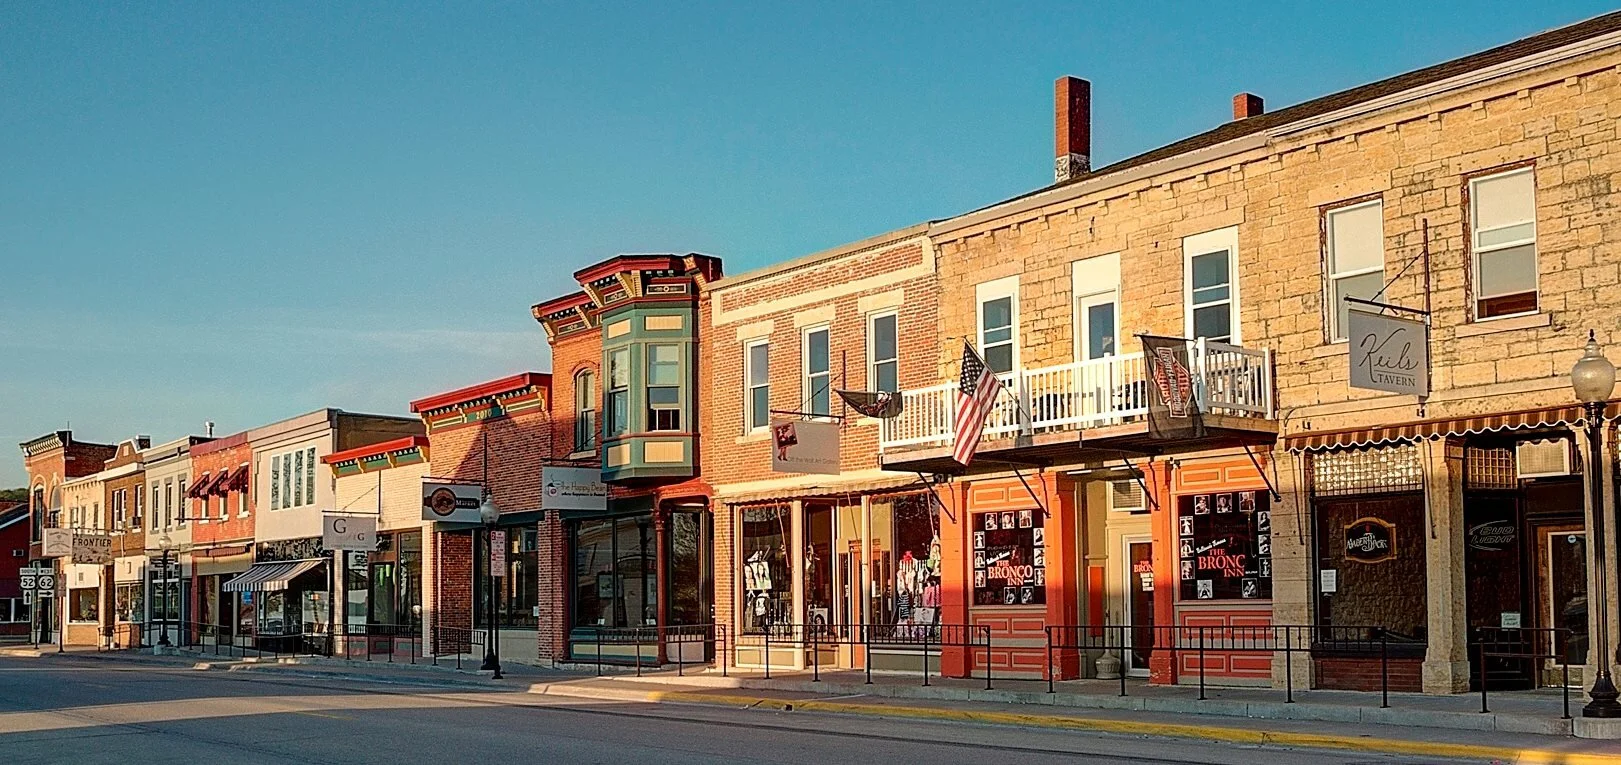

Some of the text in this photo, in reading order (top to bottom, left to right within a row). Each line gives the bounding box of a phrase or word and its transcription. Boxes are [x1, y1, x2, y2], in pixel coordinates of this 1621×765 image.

[1377, 373, 1416, 387] TAVERN
[476, 408, 493, 420] 2010
[333, 518, 347, 534] G
[357, 532, 365, 541] G
[72, 537, 112, 547] FRONTIER
[1209, 548, 1226, 556] THE
[987, 564, 1033, 579] BRONCO
[1223, 568, 1245, 577] INN
[22, 578, 34, 587] 52
[40, 578, 52, 587] 62
[1007, 577, 1024, 586] INN
